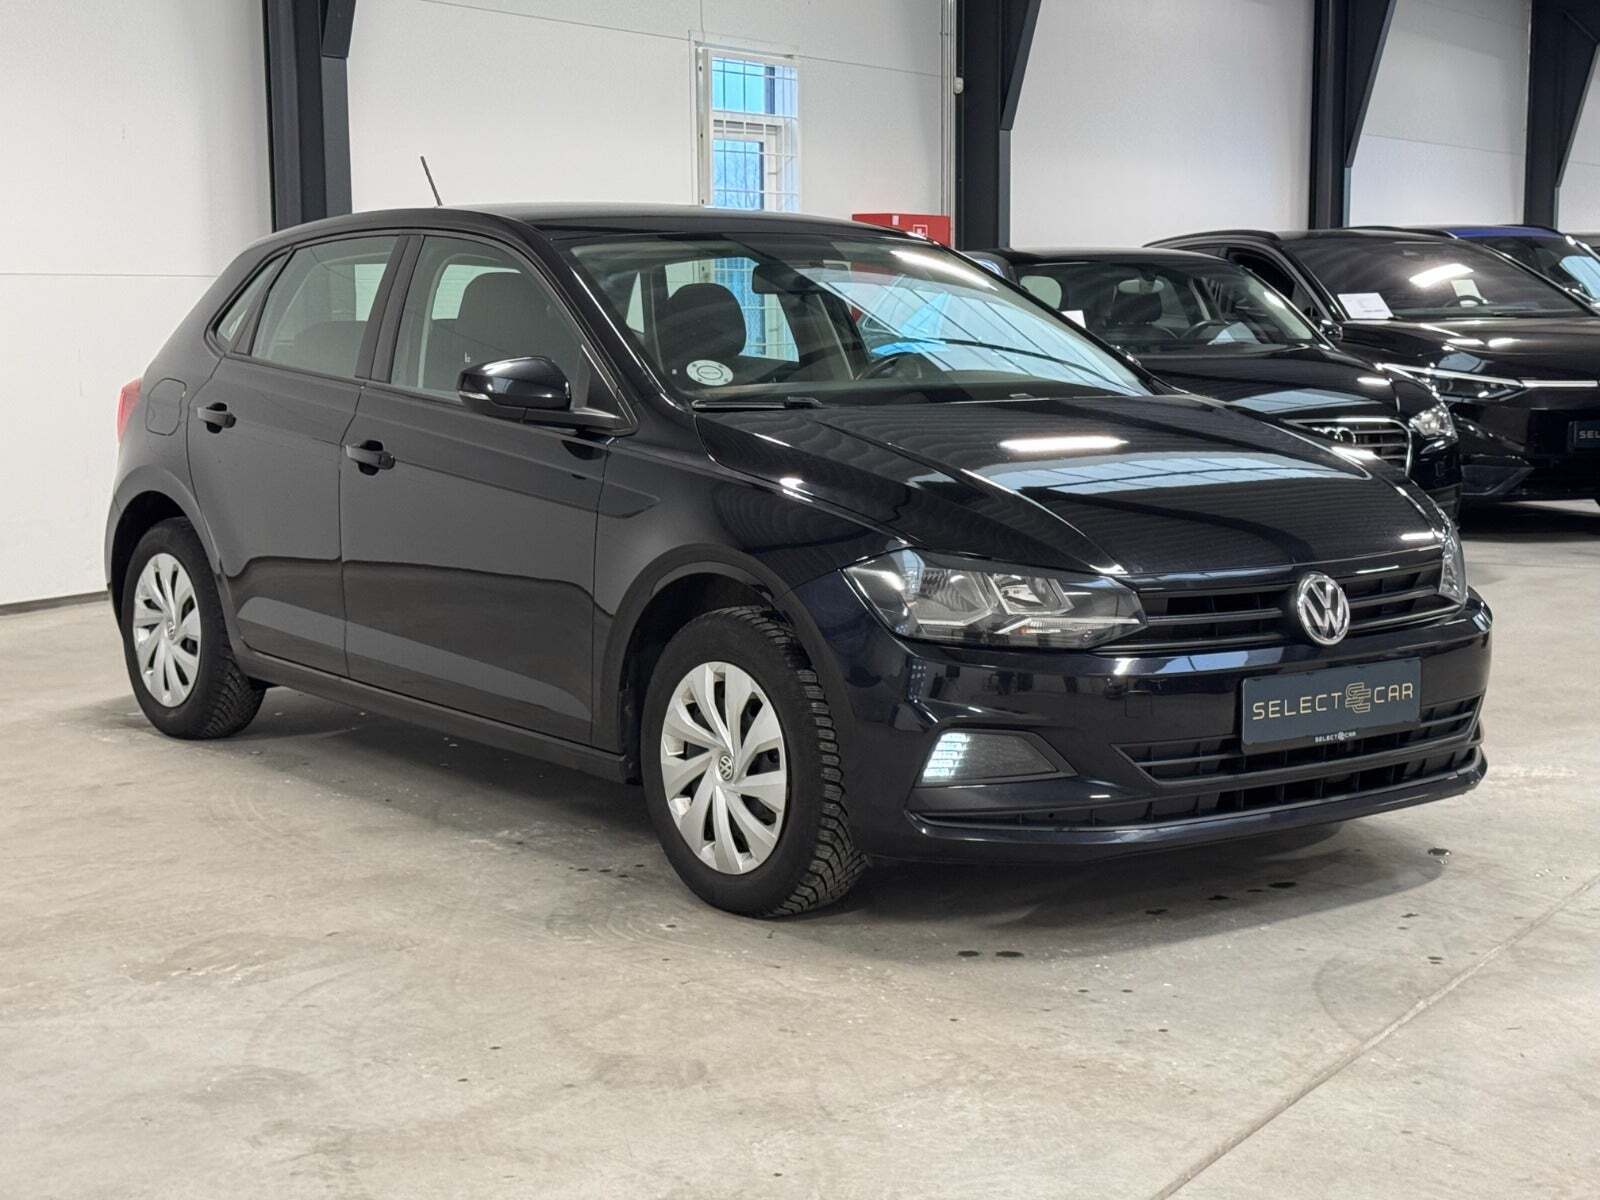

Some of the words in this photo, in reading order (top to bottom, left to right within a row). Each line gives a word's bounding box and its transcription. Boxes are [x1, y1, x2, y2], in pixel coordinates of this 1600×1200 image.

[1252, 692, 1342, 720] SELECT
[1374, 682, 1413, 704] CAR
[1314, 734, 1338, 743] SELECT
